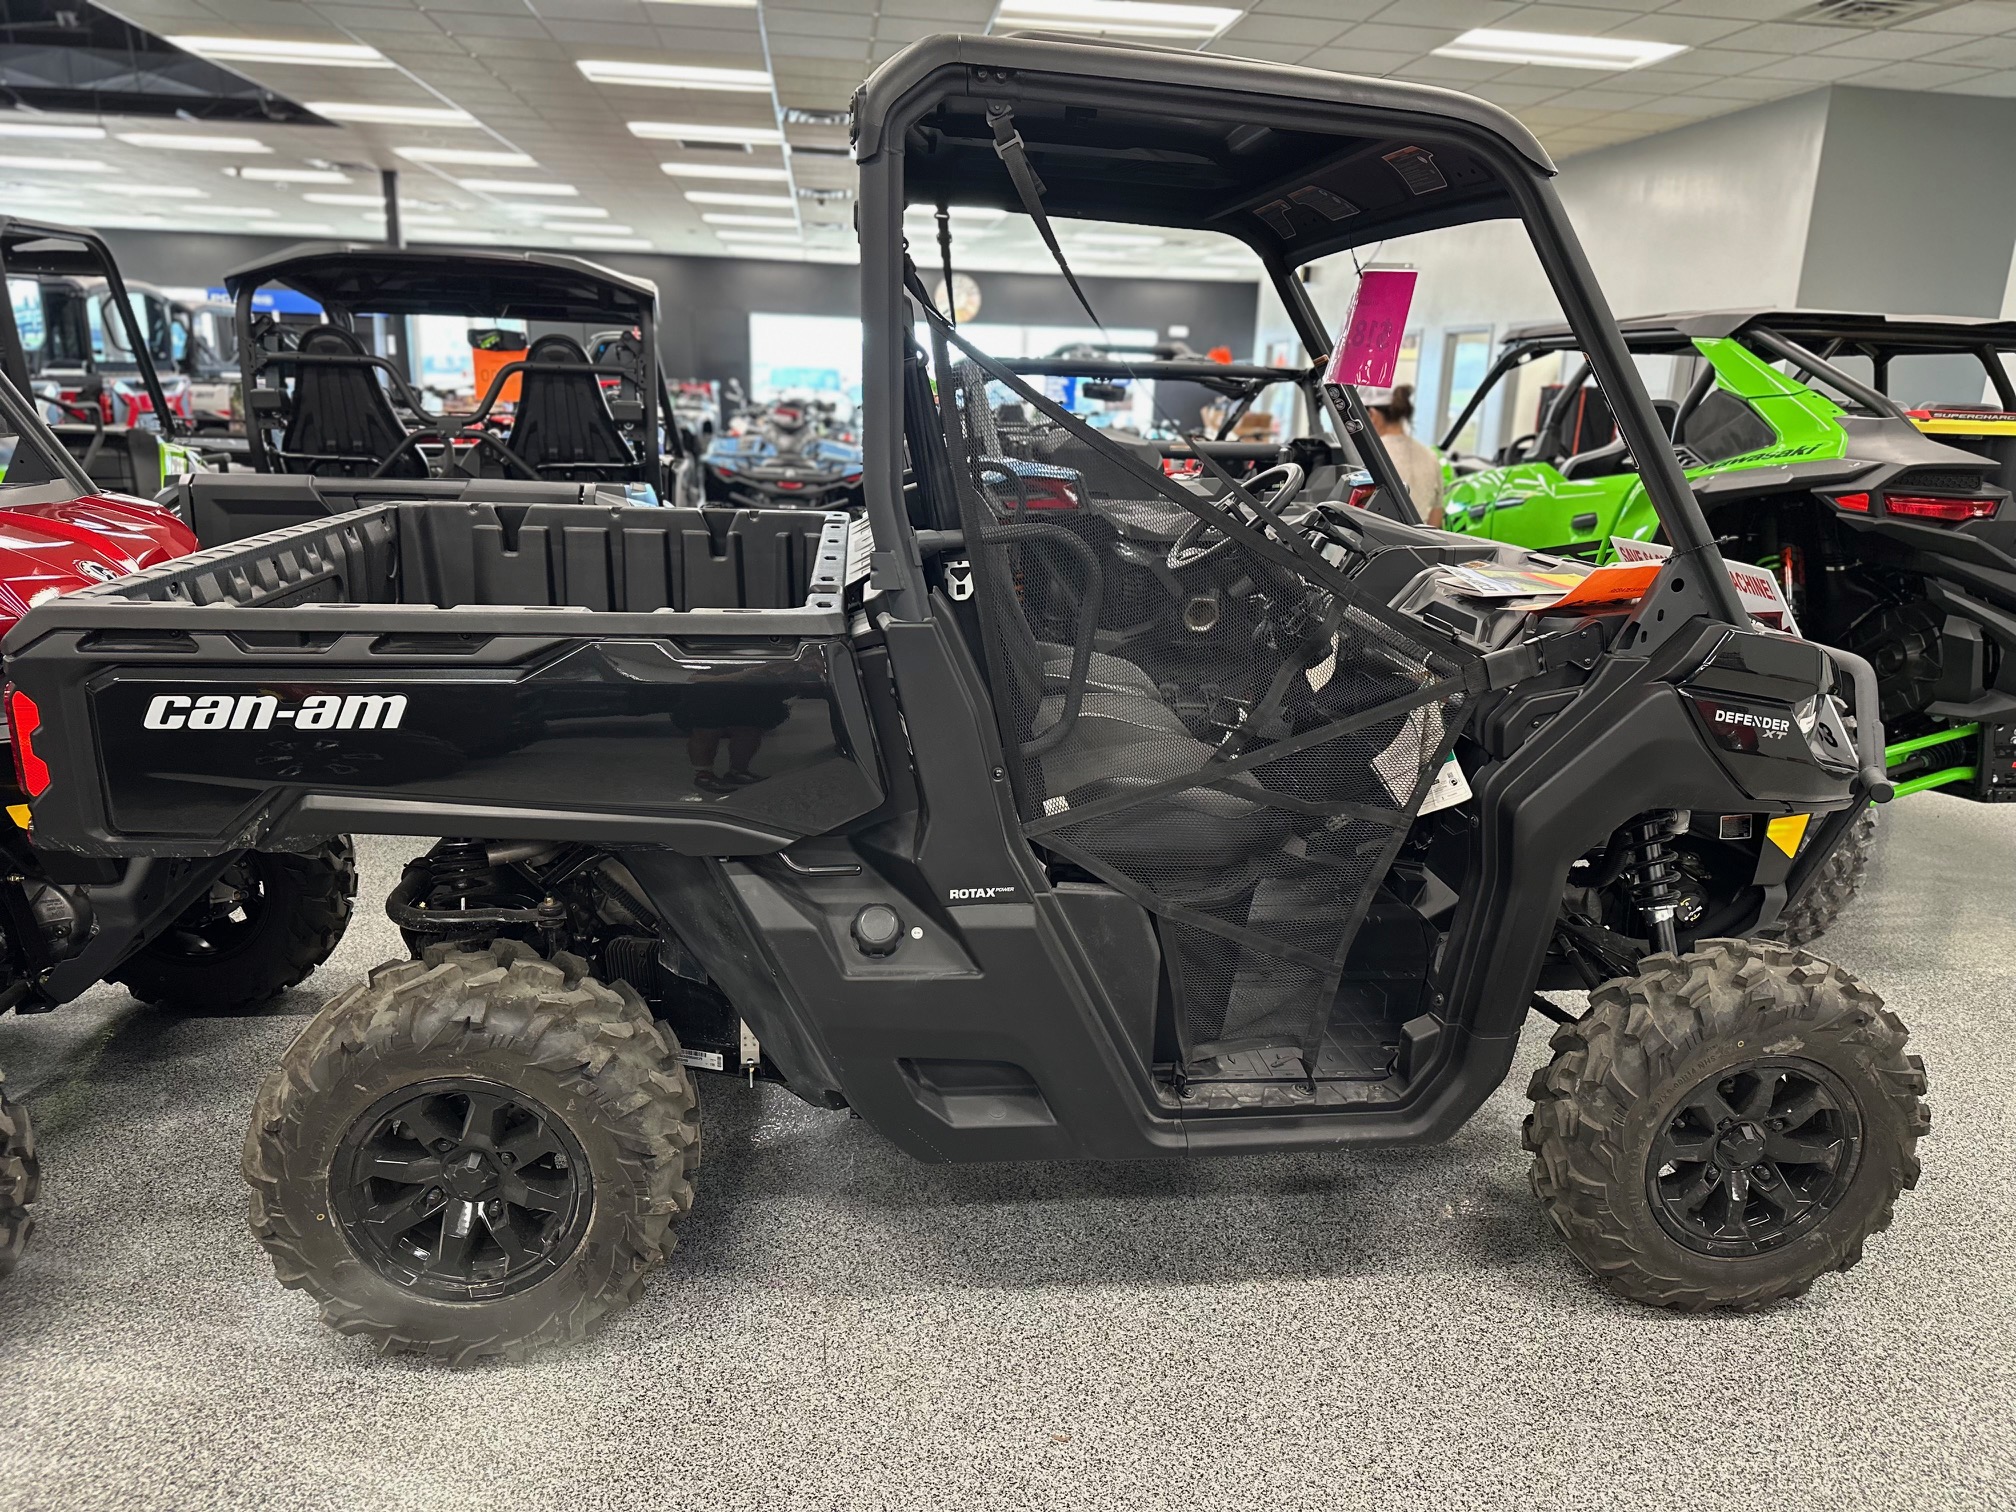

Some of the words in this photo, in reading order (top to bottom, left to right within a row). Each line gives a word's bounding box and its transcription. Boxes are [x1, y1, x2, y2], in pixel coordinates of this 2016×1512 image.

[1699, 443, 1823, 472] Kawasaki
[1729, 571, 1777, 601] ACHINE!
[143, 695, 408, 730] can-am
[1715, 709, 1790, 731] DEFENDER
[1762, 729, 1788, 740] XT
[949, 888, 996, 899] ROTAX
